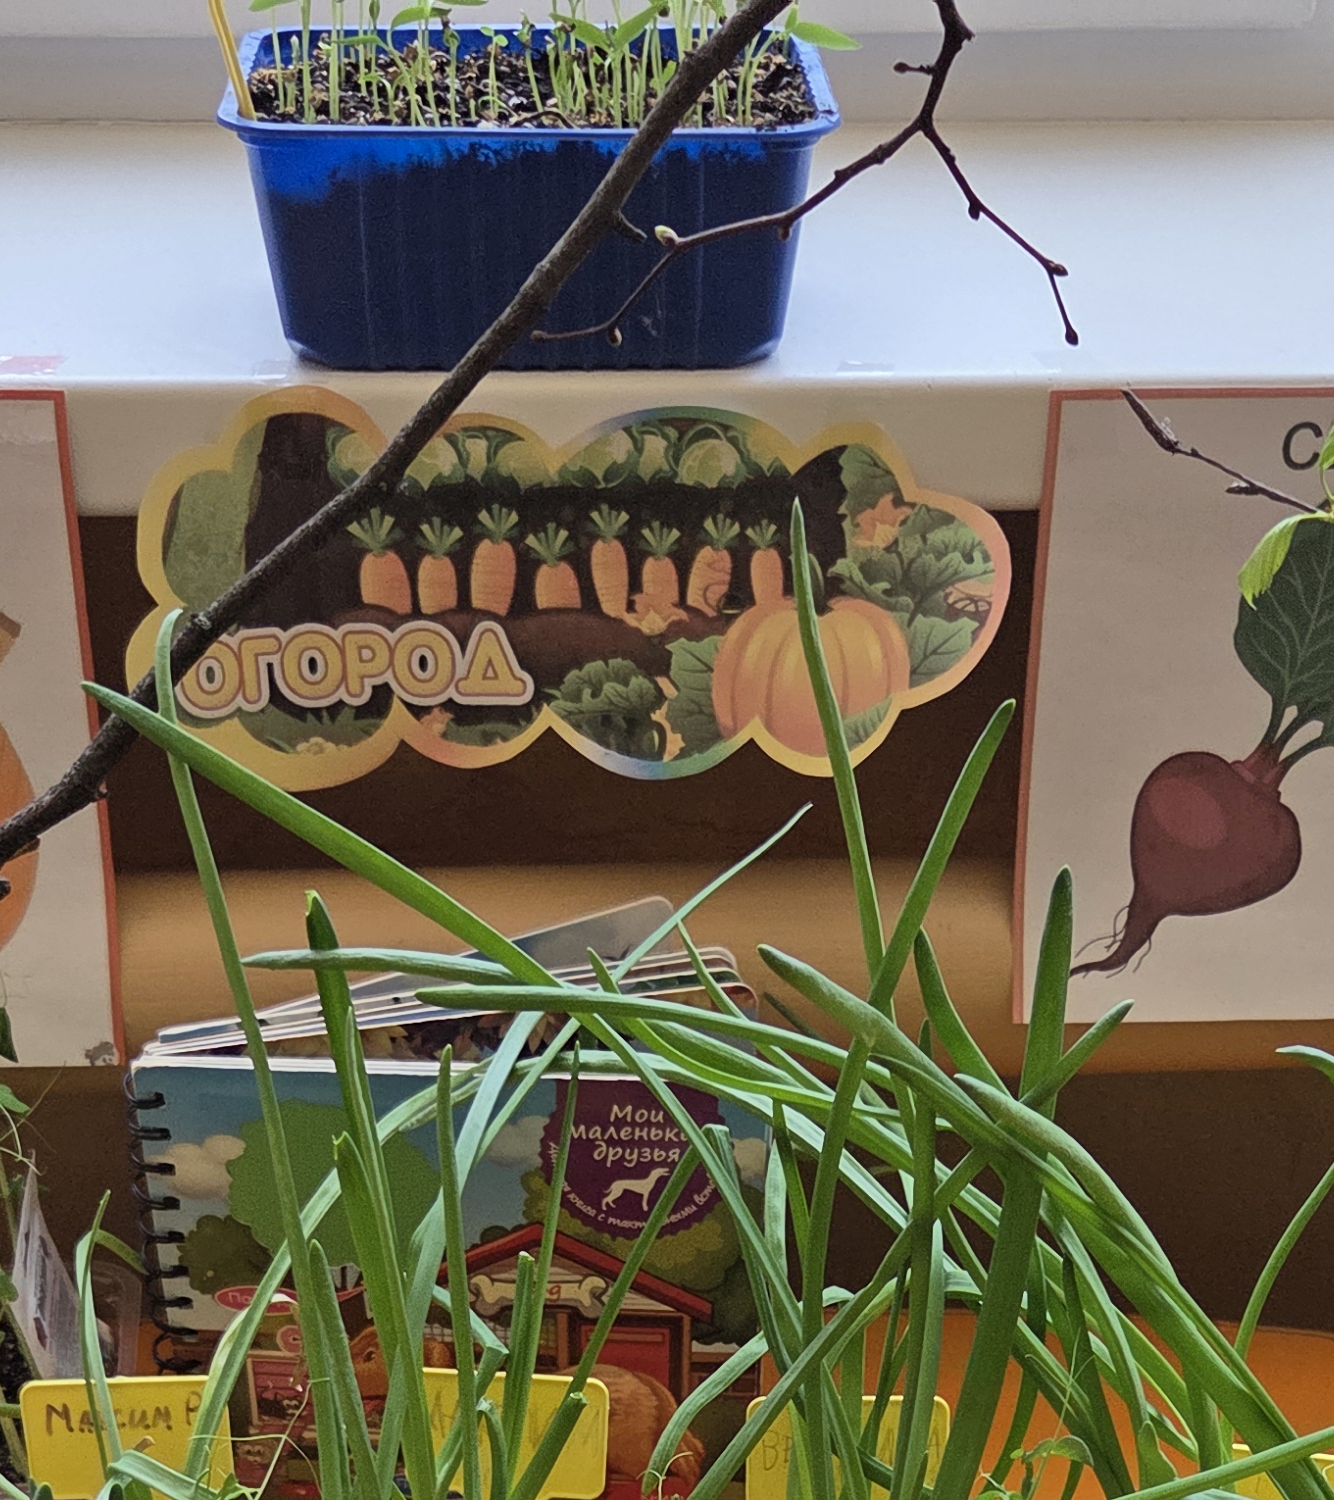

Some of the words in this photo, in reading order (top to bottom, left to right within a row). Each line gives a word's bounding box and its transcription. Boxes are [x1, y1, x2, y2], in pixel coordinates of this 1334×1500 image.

[177, 623, 533, 716] ОГОРОД
[609, 1104, 665, 1124] Мои
[592, 1141, 681, 1168] друзья
